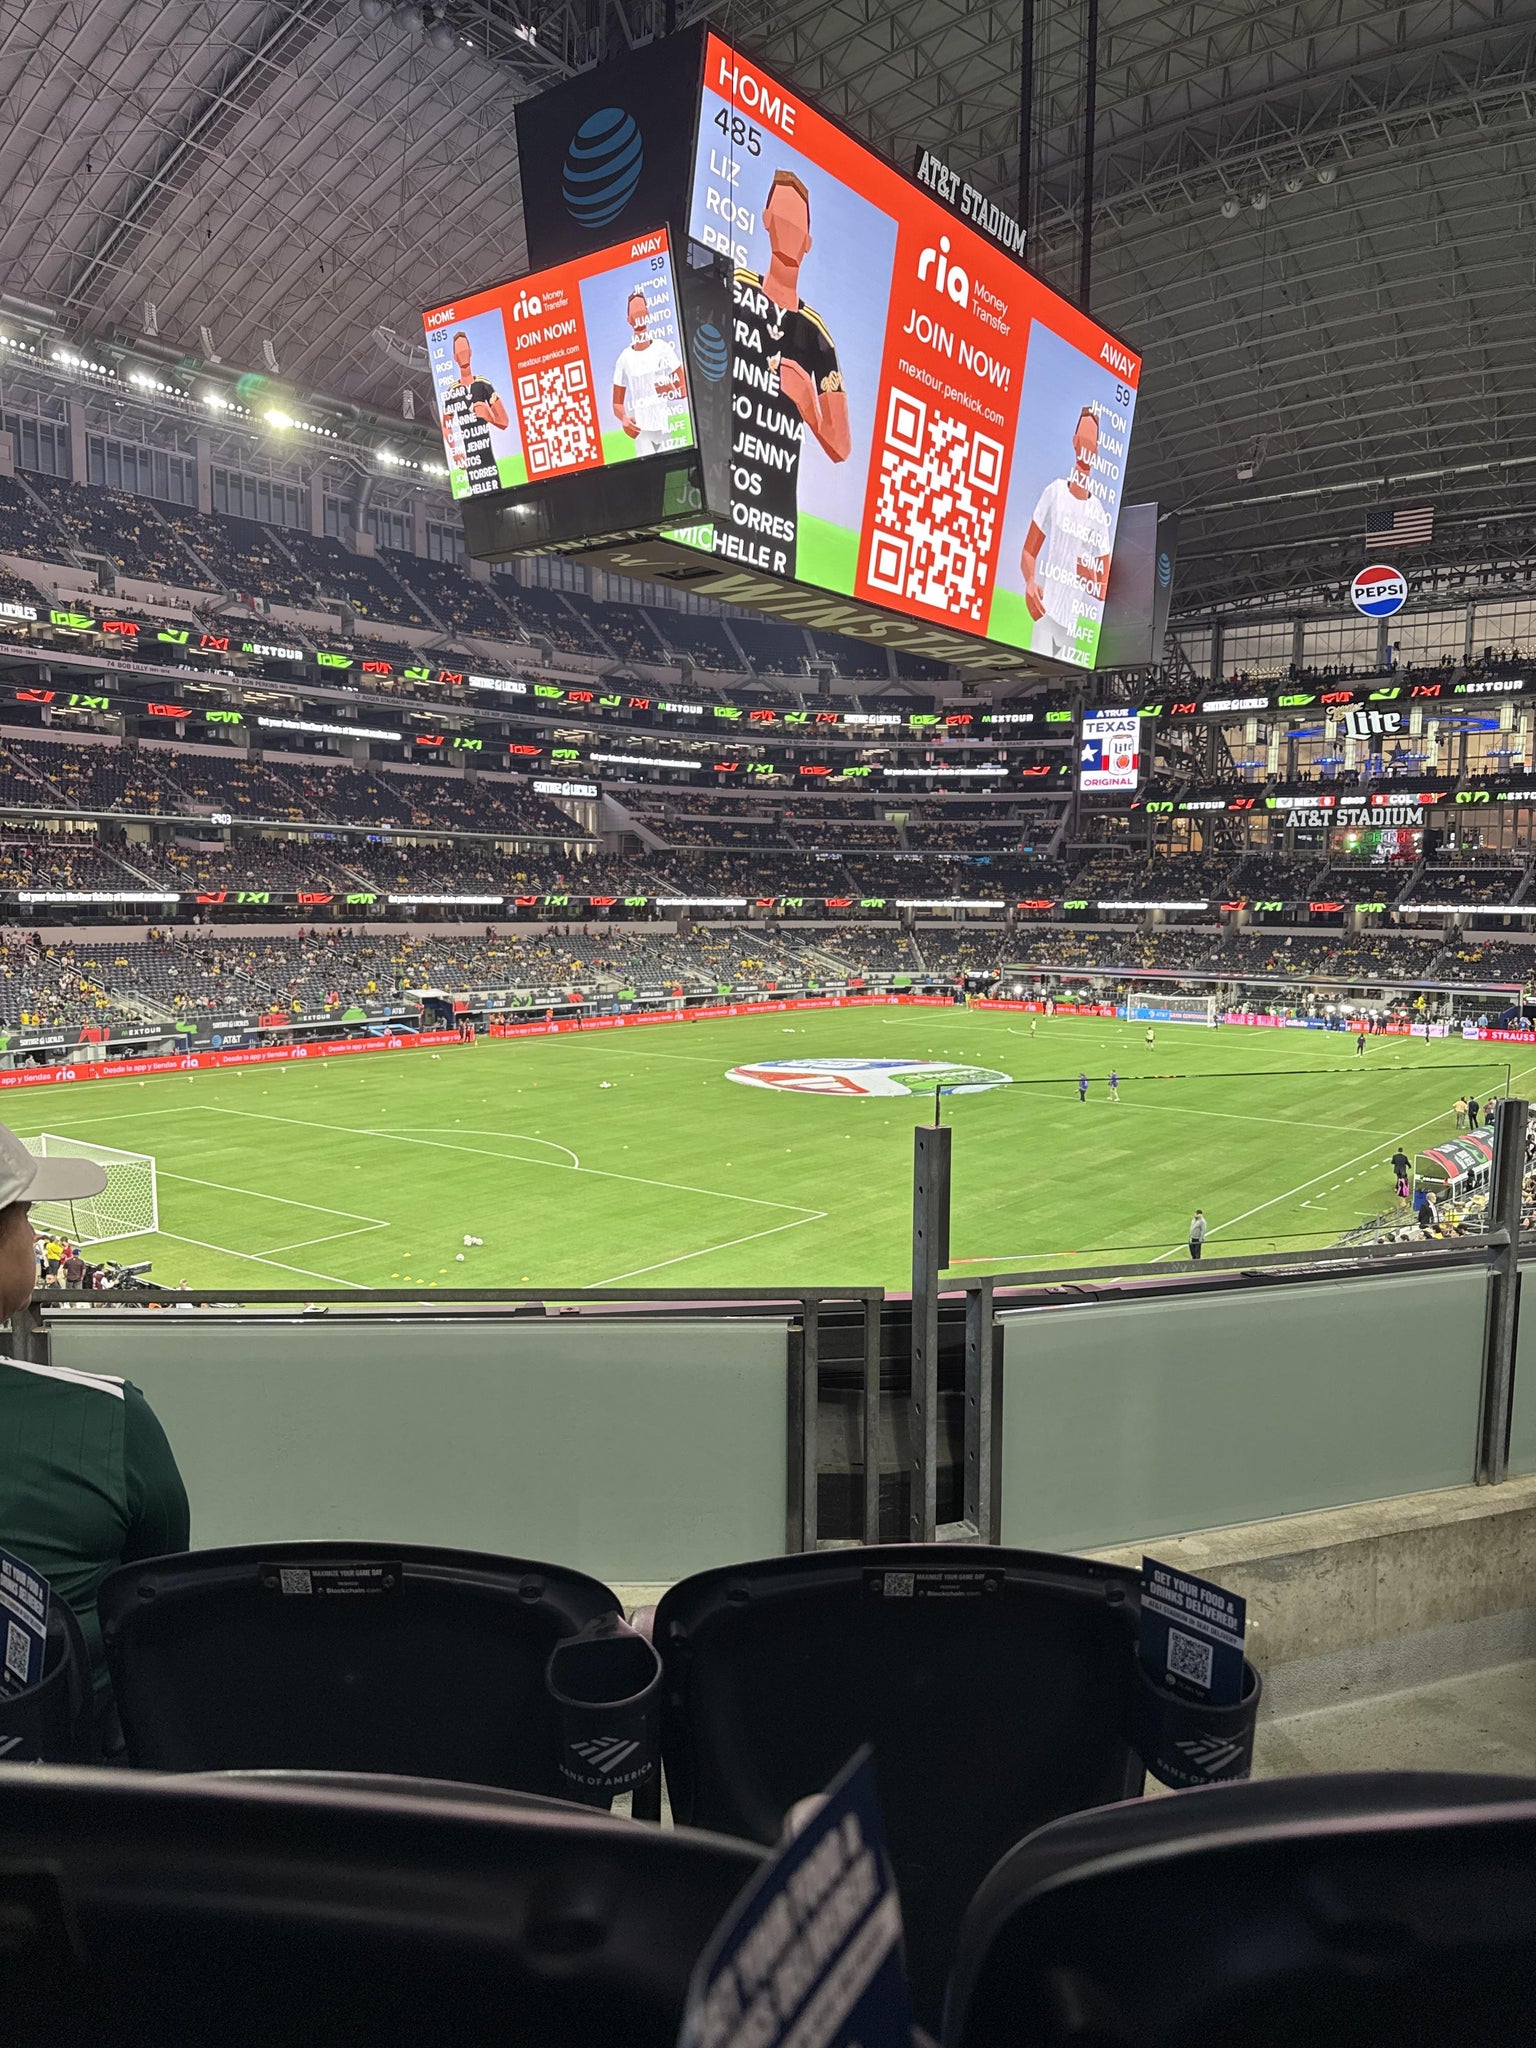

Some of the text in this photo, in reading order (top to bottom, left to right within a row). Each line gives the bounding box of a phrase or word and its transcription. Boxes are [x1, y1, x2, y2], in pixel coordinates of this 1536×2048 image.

[719, 56, 796, 136] HOME
[714, 107, 762, 157] 485
[709, 148, 741, 188] LIZ
[706, 186, 755, 235] ROSI
[917, 150, 1027, 258] AT&T STADIUM
[631, 235, 662, 258] AWAY
[702, 224, 748, 269] PRIS
[650, 256, 665, 271] 59
[917, 236, 970, 310] ria
[513, 289, 543, 322] ria
[542, 289, 564, 302] Money
[543, 298, 569, 312] Transfer
[646, 292, 670, 309] JUAN
[733, 279, 787, 326] GAR Y
[973, 280, 1008, 317] Money
[427, 308, 455, 328] HOME
[633, 308, 672, 329] JUANITO
[972, 299, 1011, 337] Transfer
[431, 329, 448, 343] 485
[514, 318, 577, 351] JOIN NOW!
[667, 324, 674, 335] R
[433, 347, 445, 359] LIZ
[903, 308, 1012, 393] JOIN NOW!
[1100, 342, 1136, 379] AWAY
[436, 361, 454, 373] ROSI
[438, 375, 454, 387] PRIS
[441, 386, 465, 401] EDGAR
[898, 358, 1005, 426] mextour.penkick.com
[1115, 384, 1130, 407] 59
[443, 400, 467, 415] LAURA
[470, 424, 490, 436] LUNA
[756, 403, 806, 445] LUNA
[467, 438, 490, 453] JENNY
[732, 431, 797, 473] JENNY
[1097, 431, 1124, 458] JUAN
[469, 465, 498, 480] TORRES
[1077, 446, 1120, 481] JUANITO
[493, 480, 499, 490] R
[1067, 467, 1116, 504] JAZMYN R
[730, 499, 795, 543] ORRES
[1085, 502, 1112, 527] MAJO
[1062, 517, 1109, 551] BARBARA
[673, 526, 787, 574] MICHELLE R
[1081, 552, 1105, 575] GINA
[1039, 560, 1101, 598] LUOBREGON
[1354, 585, 1403, 598] PEPSI
[1071, 599, 1098, 620] RAYG
[691, 574, 1025, 668] WINSTAR
[1067, 623, 1094, 644] MAFE
[242, 642, 303, 661] MEXTOUR
[1061, 644, 1090, 665] LIZZIE
[132, 664, 147, 672] LILLY
[254, 681, 279, 689] PERKINS
[1454, 680, 1523, 693] MEXTOUR
[658, 703, 703, 714] MEXTOUR
[982, 713, 1033, 723] MEXTOUR
[1096, 709, 1129, 718] A TRUE
[1086, 721, 1136, 733] TEXAS
[1344, 711, 1402, 740] Lite
[1084, 778, 1133, 786] ORIGINAL
[1178, 801, 1225, 811] MEXTOUR
[1389, 794, 1413, 805] COL
[1286, 807, 1424, 828] AT&T STADIUM
[391, 1007, 406, 1015] AT&T
[121, 1027, 161, 1036] MEXTOUR
[223, 1035, 242, 1044] AT&T
[1491, 1032, 1536, 1041] STRAUSS
[352, 1043, 362, 1052] app
[367, 1041, 386, 1049] tiendas
[388, 1035, 402, 1048] ria
[103, 1055, 199, 1074] Desde la app y tiendas ria
[223, 1055, 242, 1063] Desde
[250, 1053, 261, 1061] app
[267, 1050, 288, 1059] tiendas
[291, 1046, 307, 1058] ria
[2, 1076, 16, 1085] app
[24, 1072, 51, 1082] tiendas
[55, 1067, 76, 1080] ria
[1154, 1570, 1234, 1615] GET YOUR FOOD &
[1150, 1581, 1238, 1631] DRINKS DELIVERED!
[1210, 1626, 1237, 1645] DELIVERY
[587, 1777, 602, 1786] OF
[604, 1761, 652, 1786] AMERICA
